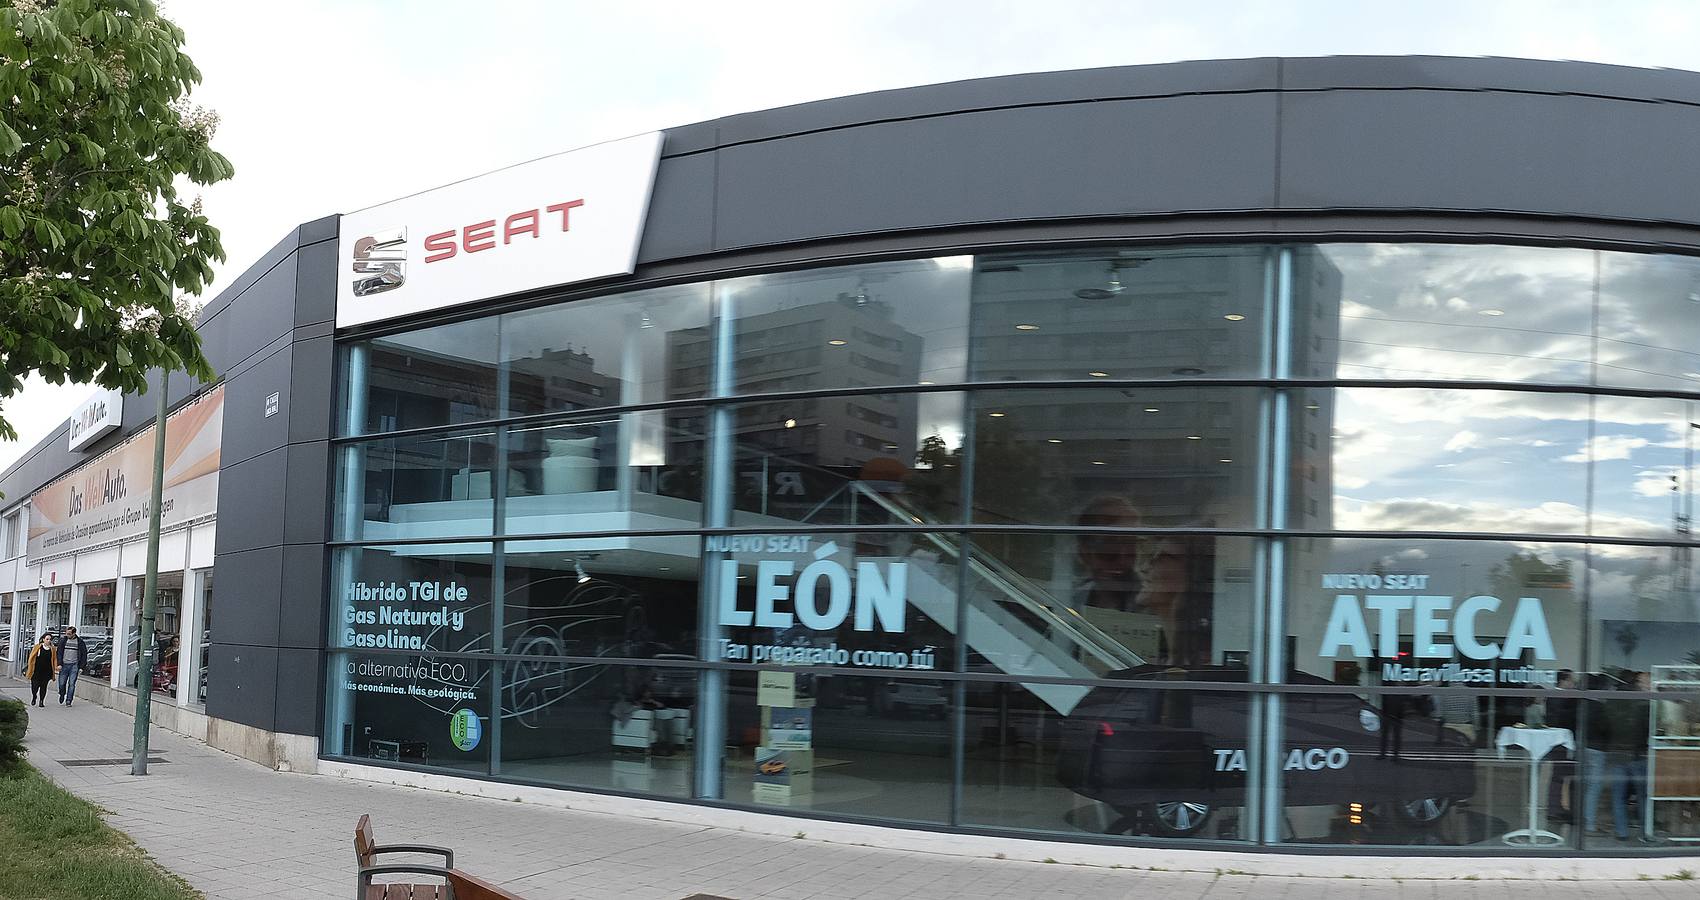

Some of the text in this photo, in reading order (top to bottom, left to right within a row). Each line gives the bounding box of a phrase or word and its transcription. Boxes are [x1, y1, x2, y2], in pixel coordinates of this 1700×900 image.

[424, 198, 585, 264] SEAT
[69, 486, 83, 517] Das
[121, 507, 126, 526] el
[126, 507, 141, 527] Grupo
[706, 536, 811, 553] NUEVO SEAT
[346, 581, 468, 602] Híbrido TGI de
[719, 540, 908, 633] LEÓN
[1321, 574, 1430, 590] NUEVO SEAT
[343, 605, 464, 632] Gas Natural y
[1318, 594, 1558, 661] ATECA
[343, 627, 426, 651] Gasolina.
[719, 639, 748, 660] Tan
[752, 643, 850, 666] preparado
[852, 653, 909, 669] como
[358, 659, 427, 679] alternativa
[432, 662, 468, 682] ECO.
[1383, 663, 1557, 686] Maravillosa rutina
[341, 681, 477, 701] Más económica. Más ecológica.
[1213, 747, 1350, 772] TAACO
